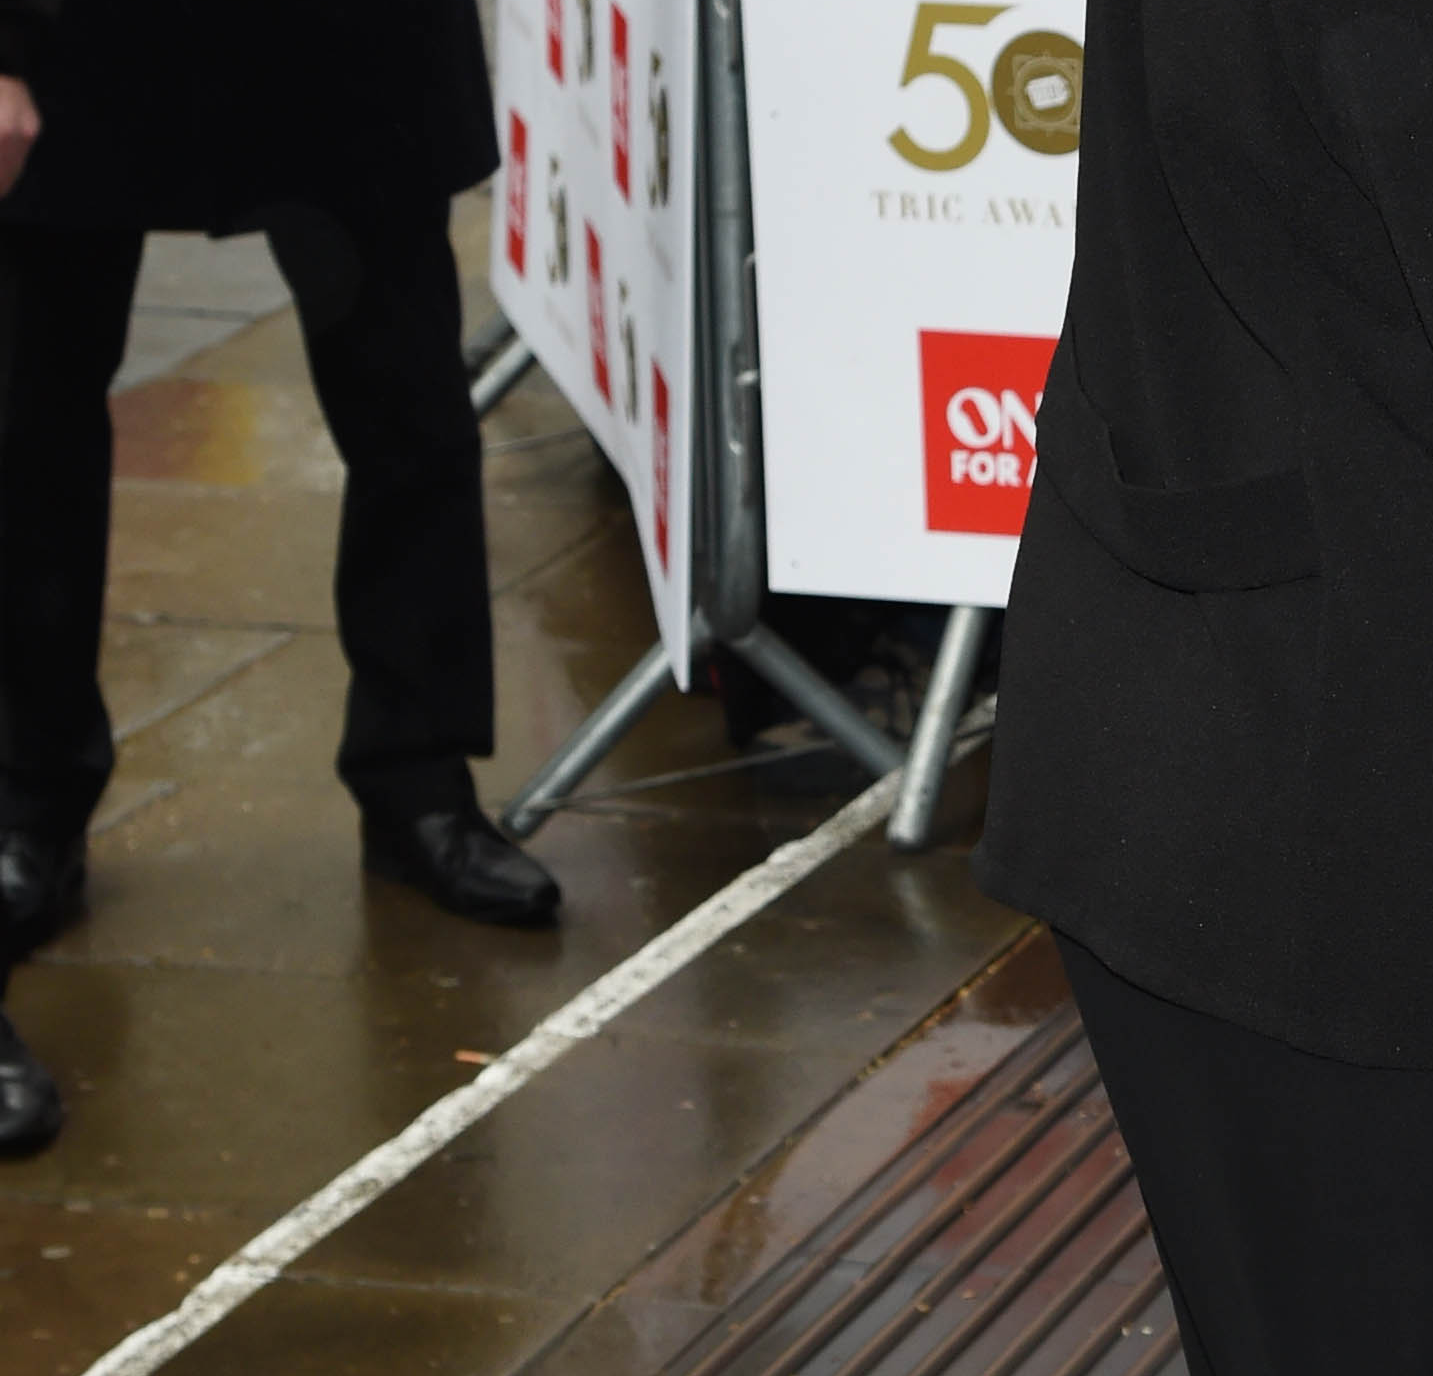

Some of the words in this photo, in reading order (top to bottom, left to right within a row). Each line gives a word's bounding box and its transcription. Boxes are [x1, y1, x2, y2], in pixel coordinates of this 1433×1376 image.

[870, 188, 963, 223] TRIC
[983, 195, 1066, 231] AWA
[946, 385, 1044, 452] ON
[951, 448, 1022, 488] FOR
